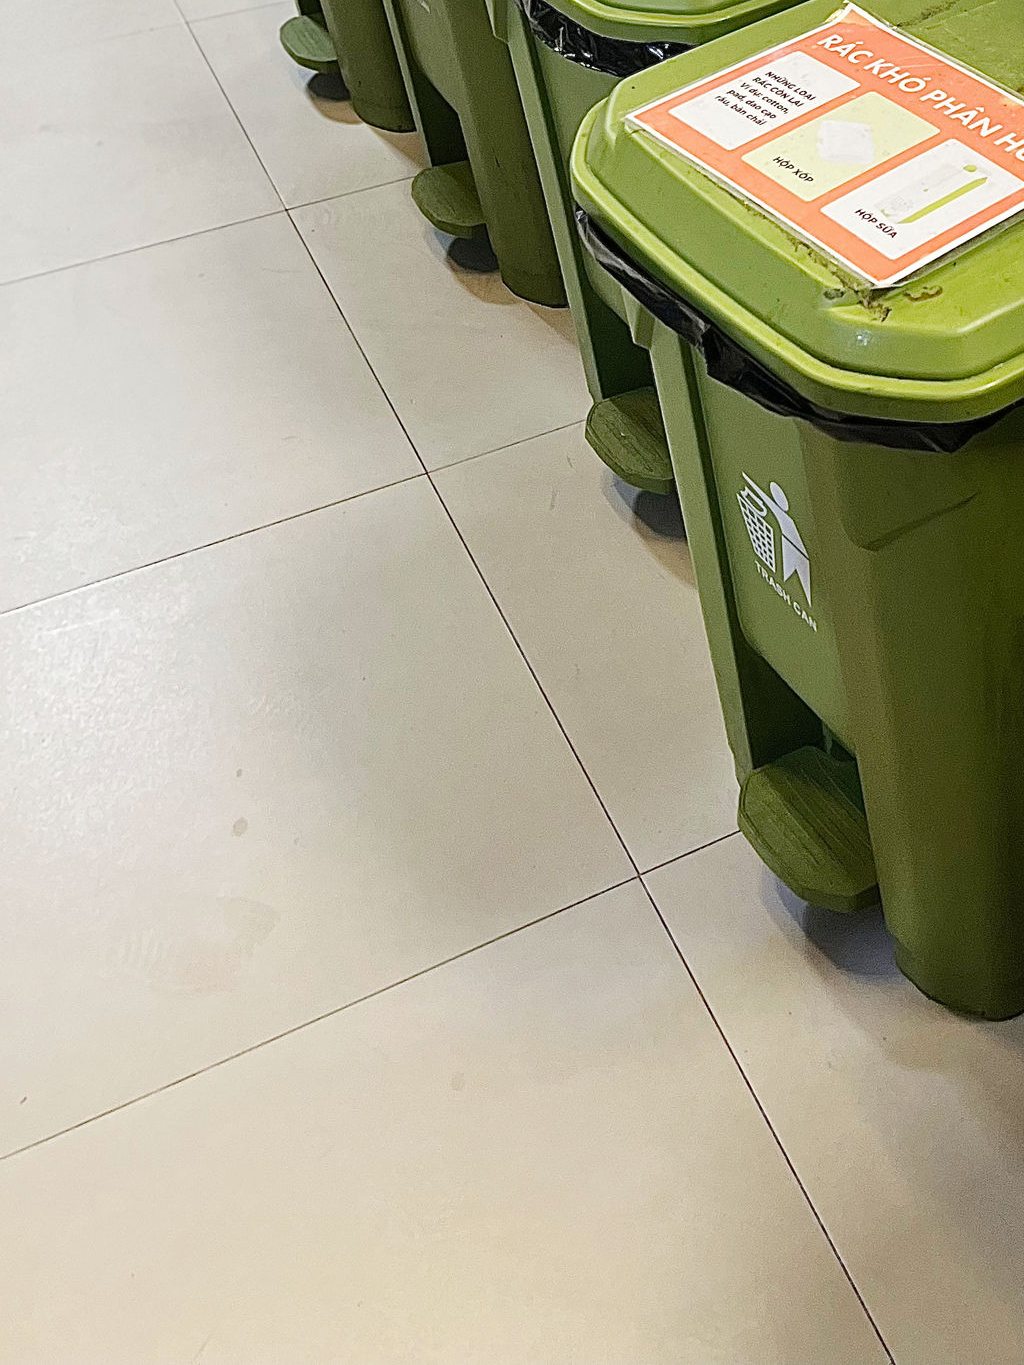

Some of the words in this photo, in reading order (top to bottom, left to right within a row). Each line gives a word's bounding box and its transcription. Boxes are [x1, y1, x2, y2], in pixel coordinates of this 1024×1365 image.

[752, 76, 773, 89] RÁC
[770, 86, 789, 99] CÒN
[764, 71, 797, 90] NHỮNG
[817, 33, 874, 64] RÁC
[864, 58, 932, 93] KHÓ
[919, 88, 1004, 138] PHÂN
[745, 99, 762, 111] dao
[761, 109, 777, 120] cạo
[762, 95, 789, 115] cotton,
[773, 156, 795, 171] HỘP
[792, 168, 814, 183] XỐP
[854, 208, 878, 224] HỘP
[875, 222, 898, 239] SỮA
[754, 559, 791, 606] TRASH
[793, 601, 818, 634] CAN
